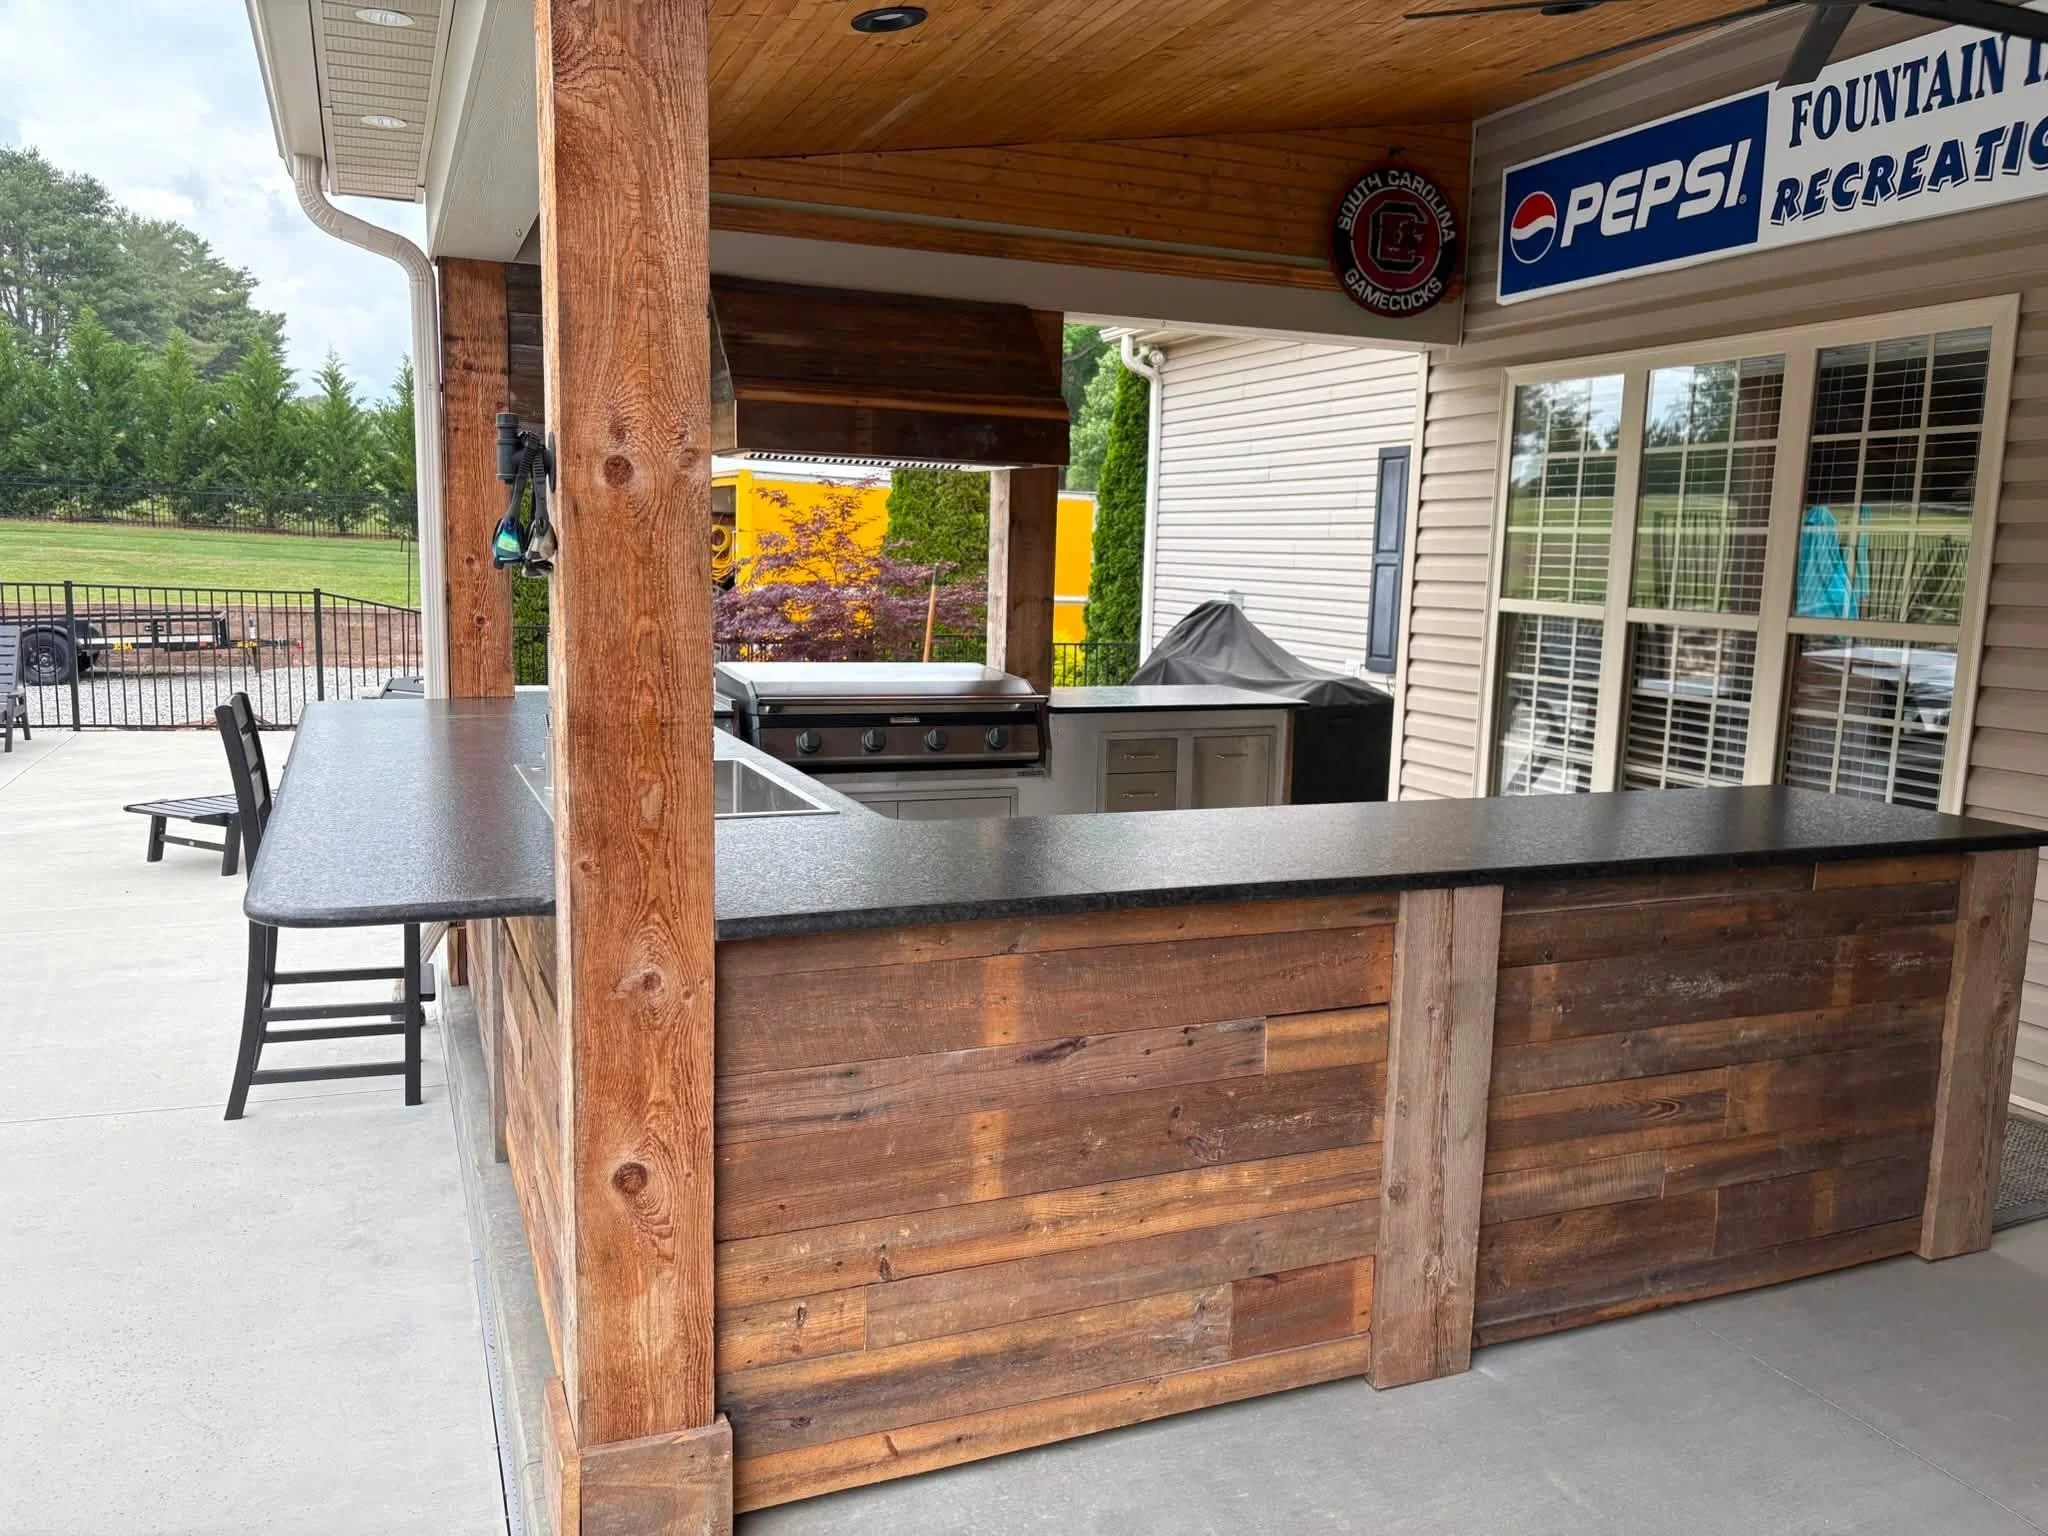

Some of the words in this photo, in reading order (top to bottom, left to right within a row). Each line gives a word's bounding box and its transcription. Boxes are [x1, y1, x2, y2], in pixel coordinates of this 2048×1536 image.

[1789, 33, 2011, 148] FOUNTAIN
[1337, 173, 1382, 231] SOUTH
[1387, 170, 1456, 243] CAROLINA
[1560, 139, 1751, 248] PEPSI
[1345, 268, 1442, 311] GAMECOCKS
